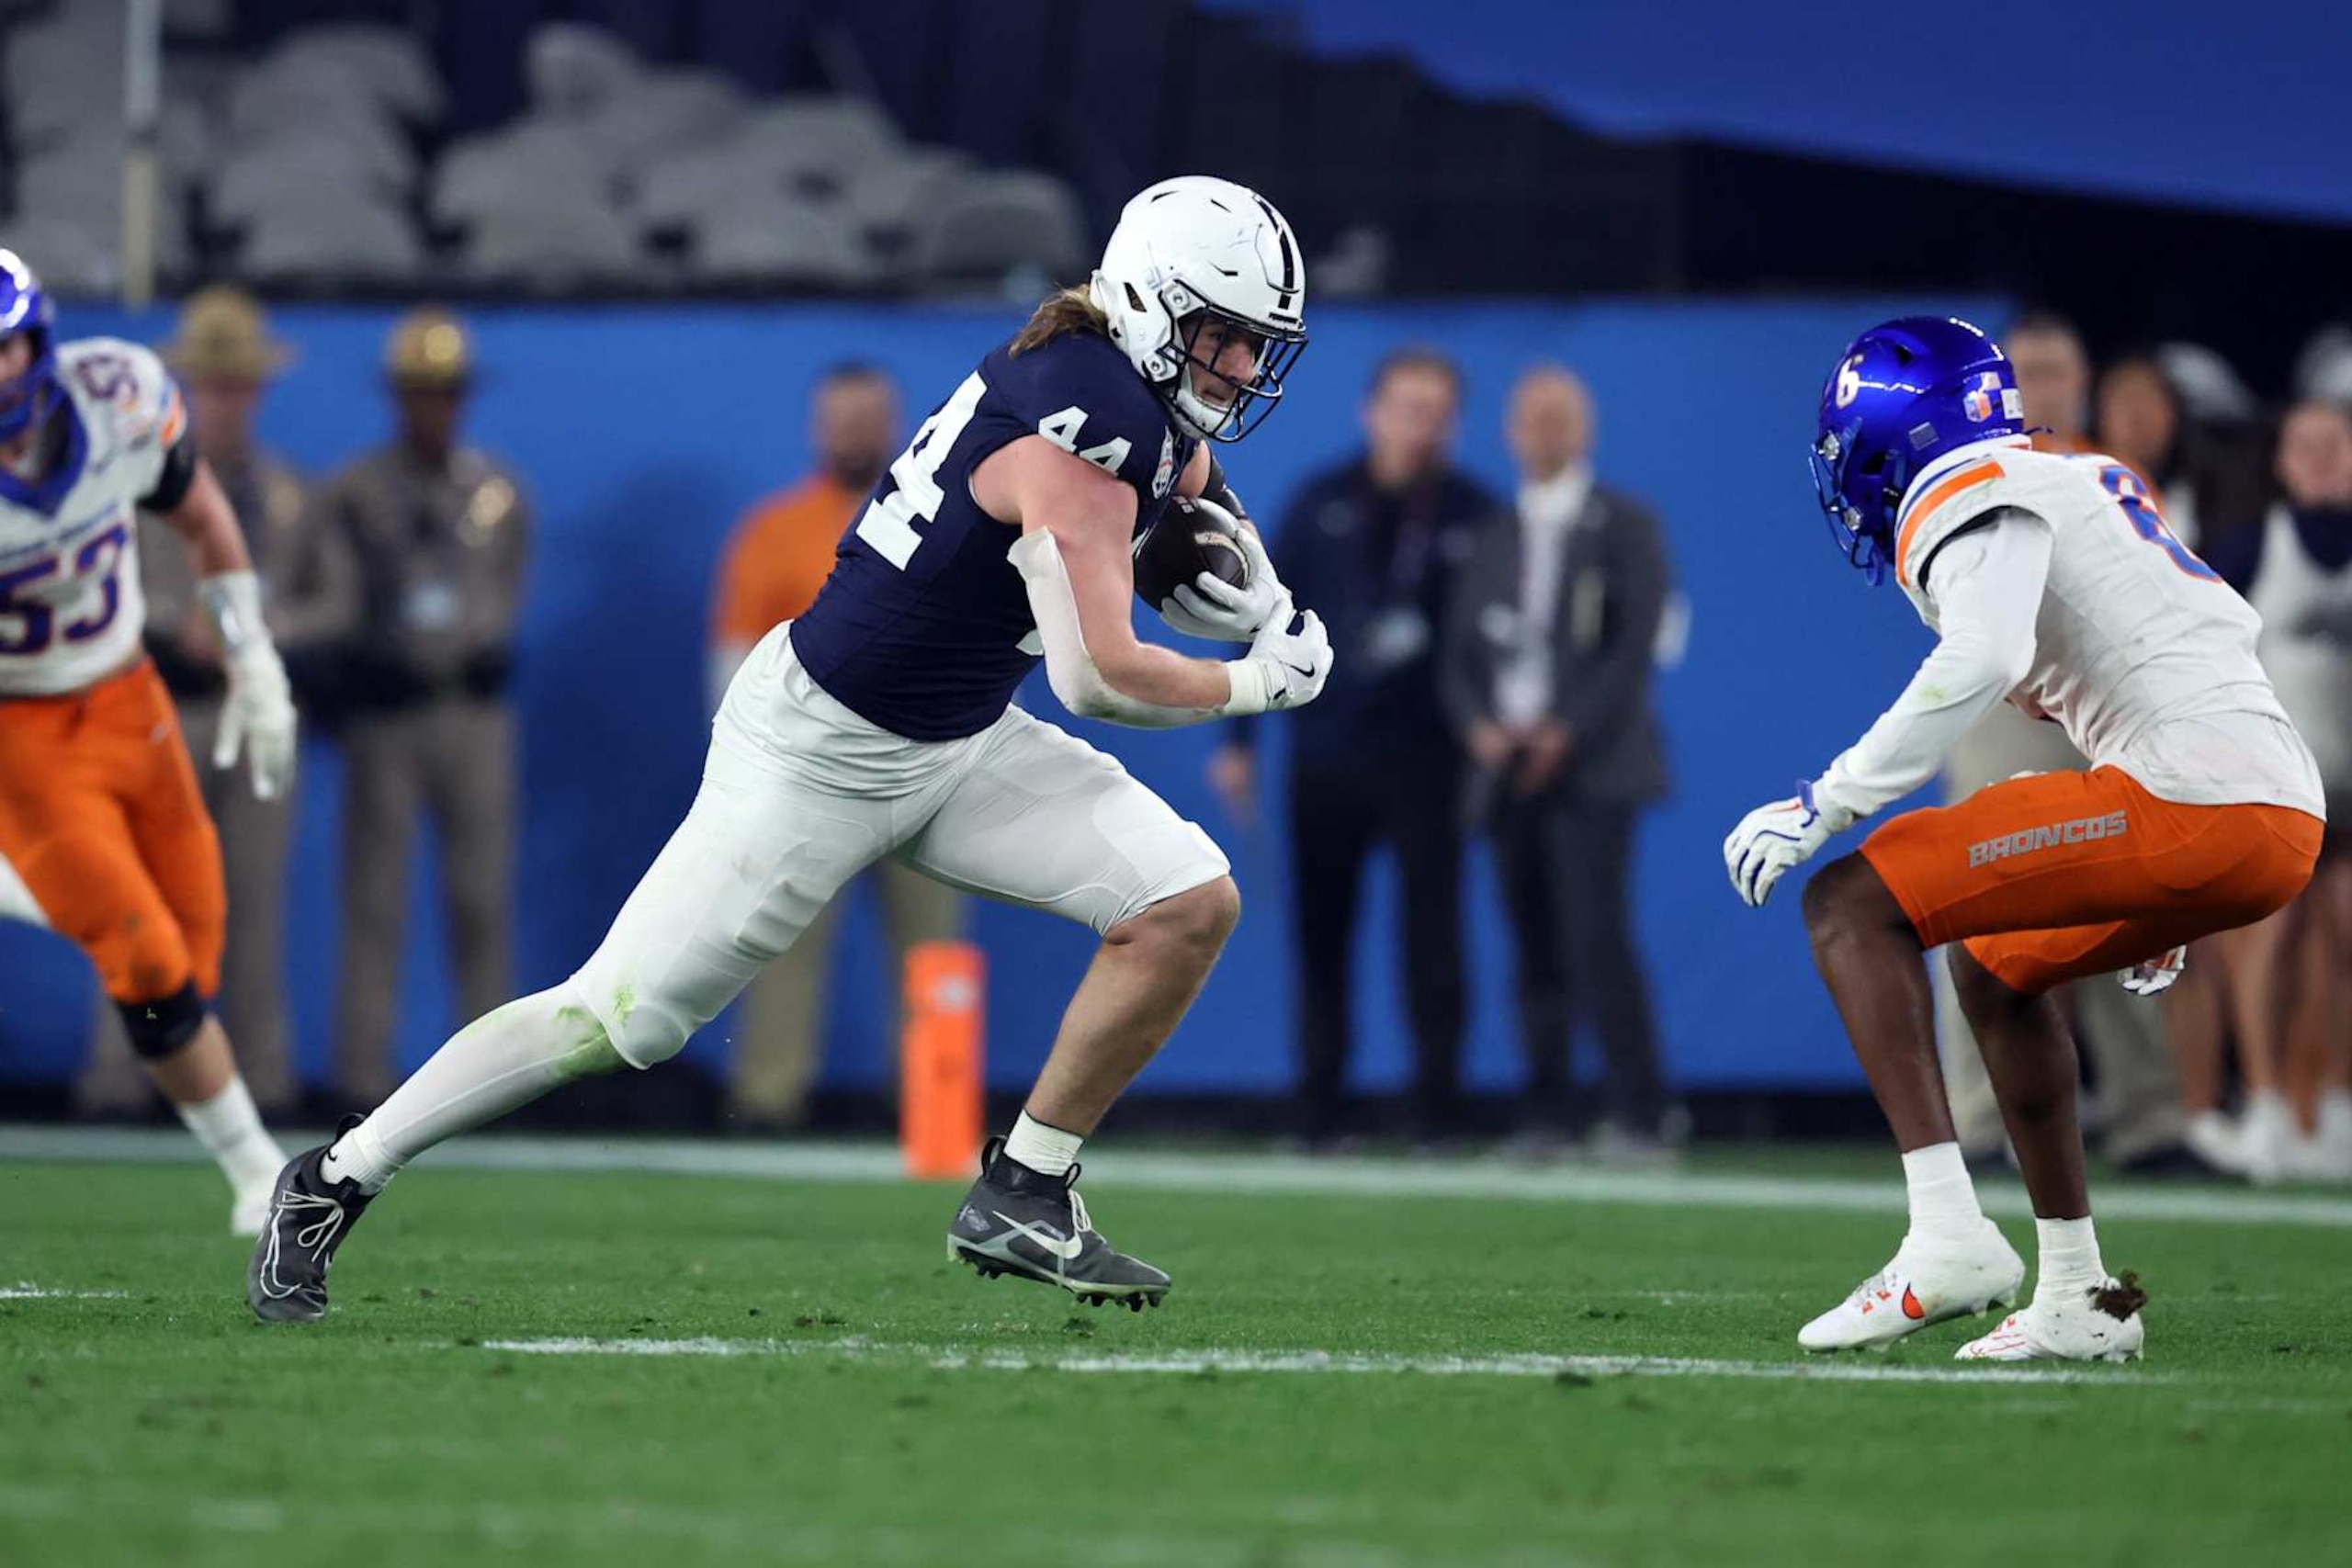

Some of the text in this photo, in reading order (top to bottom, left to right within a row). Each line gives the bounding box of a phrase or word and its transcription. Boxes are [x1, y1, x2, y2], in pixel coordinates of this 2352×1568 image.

[1836, 355, 1864, 409] 6
[1037, 405, 1133, 477] 44
[0, 521, 129, 656] 53
[1967, 809, 2128, 868] BRONCOS
